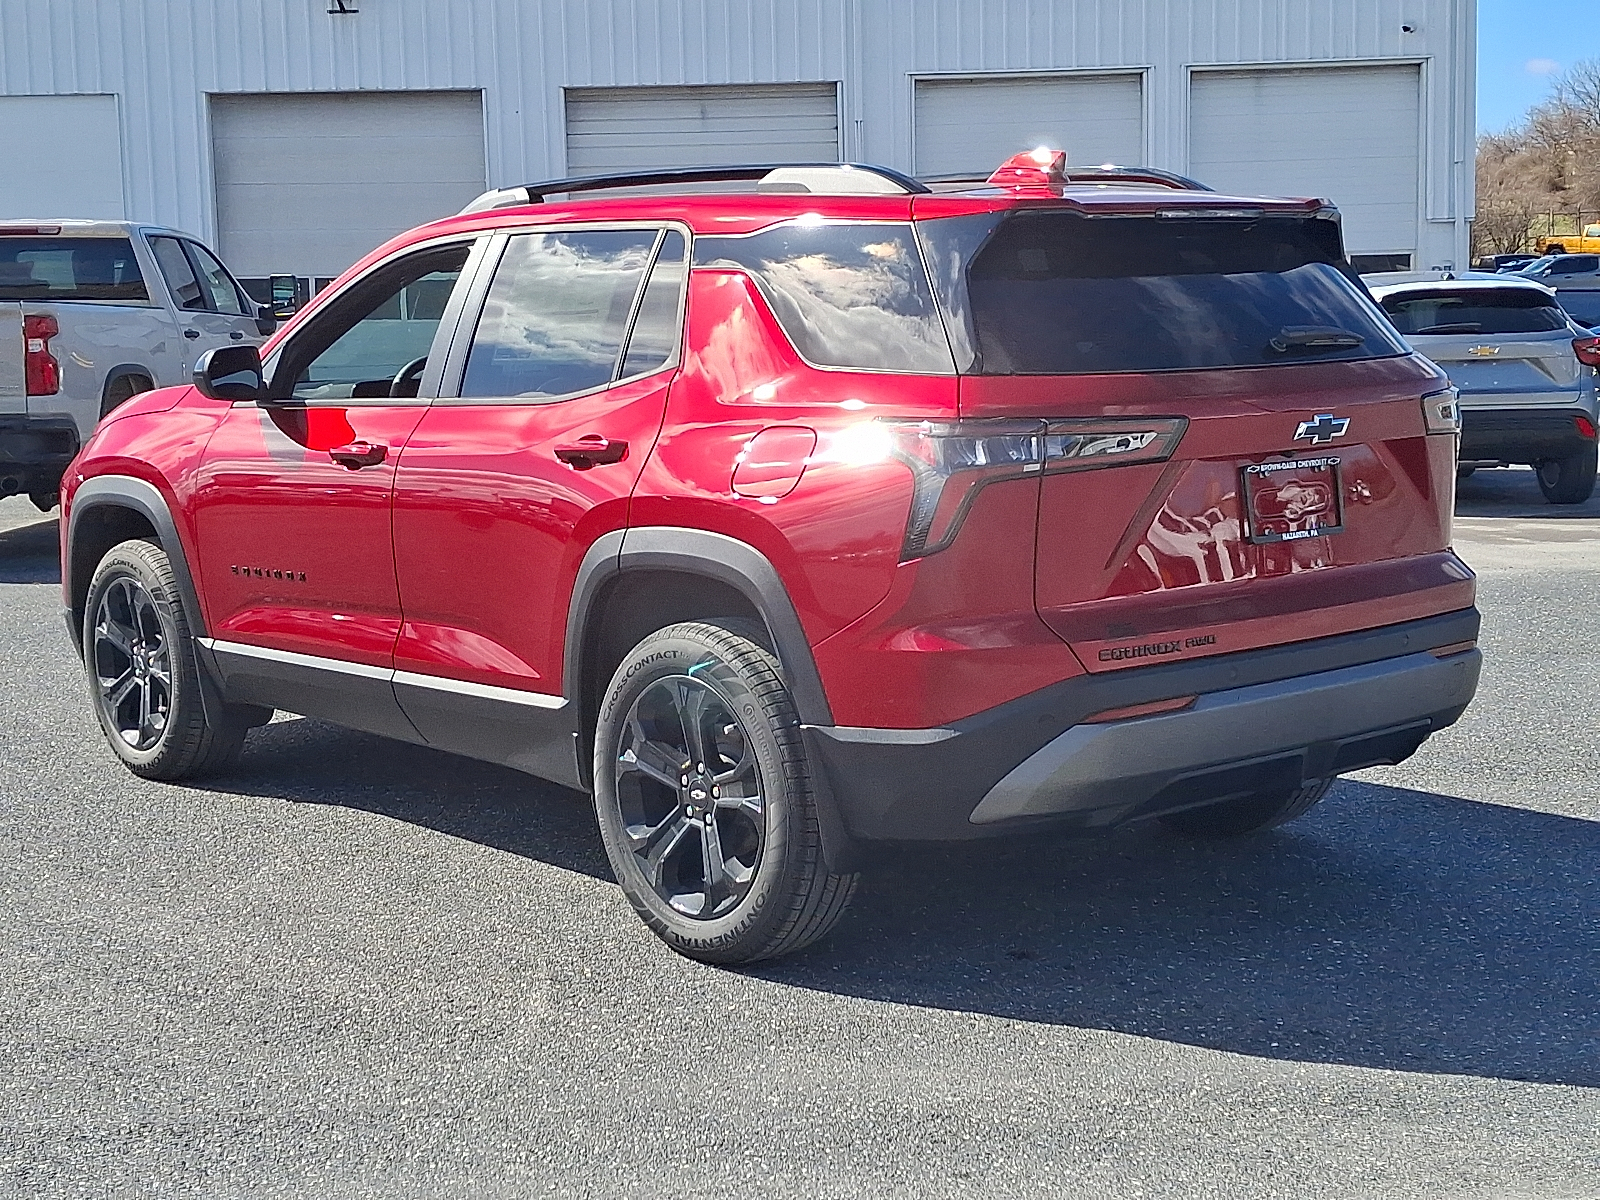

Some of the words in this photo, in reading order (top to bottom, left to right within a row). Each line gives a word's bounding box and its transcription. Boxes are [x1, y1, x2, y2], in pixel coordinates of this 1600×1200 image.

[1297, 458, 1328, 468] CHEVROLET
[1310, 528, 1319, 538] PA
[230, 564, 307, 583] EQUINOX
[1098, 640, 1182, 662] EQUINOX
[1185, 634, 1217, 648] AWD
